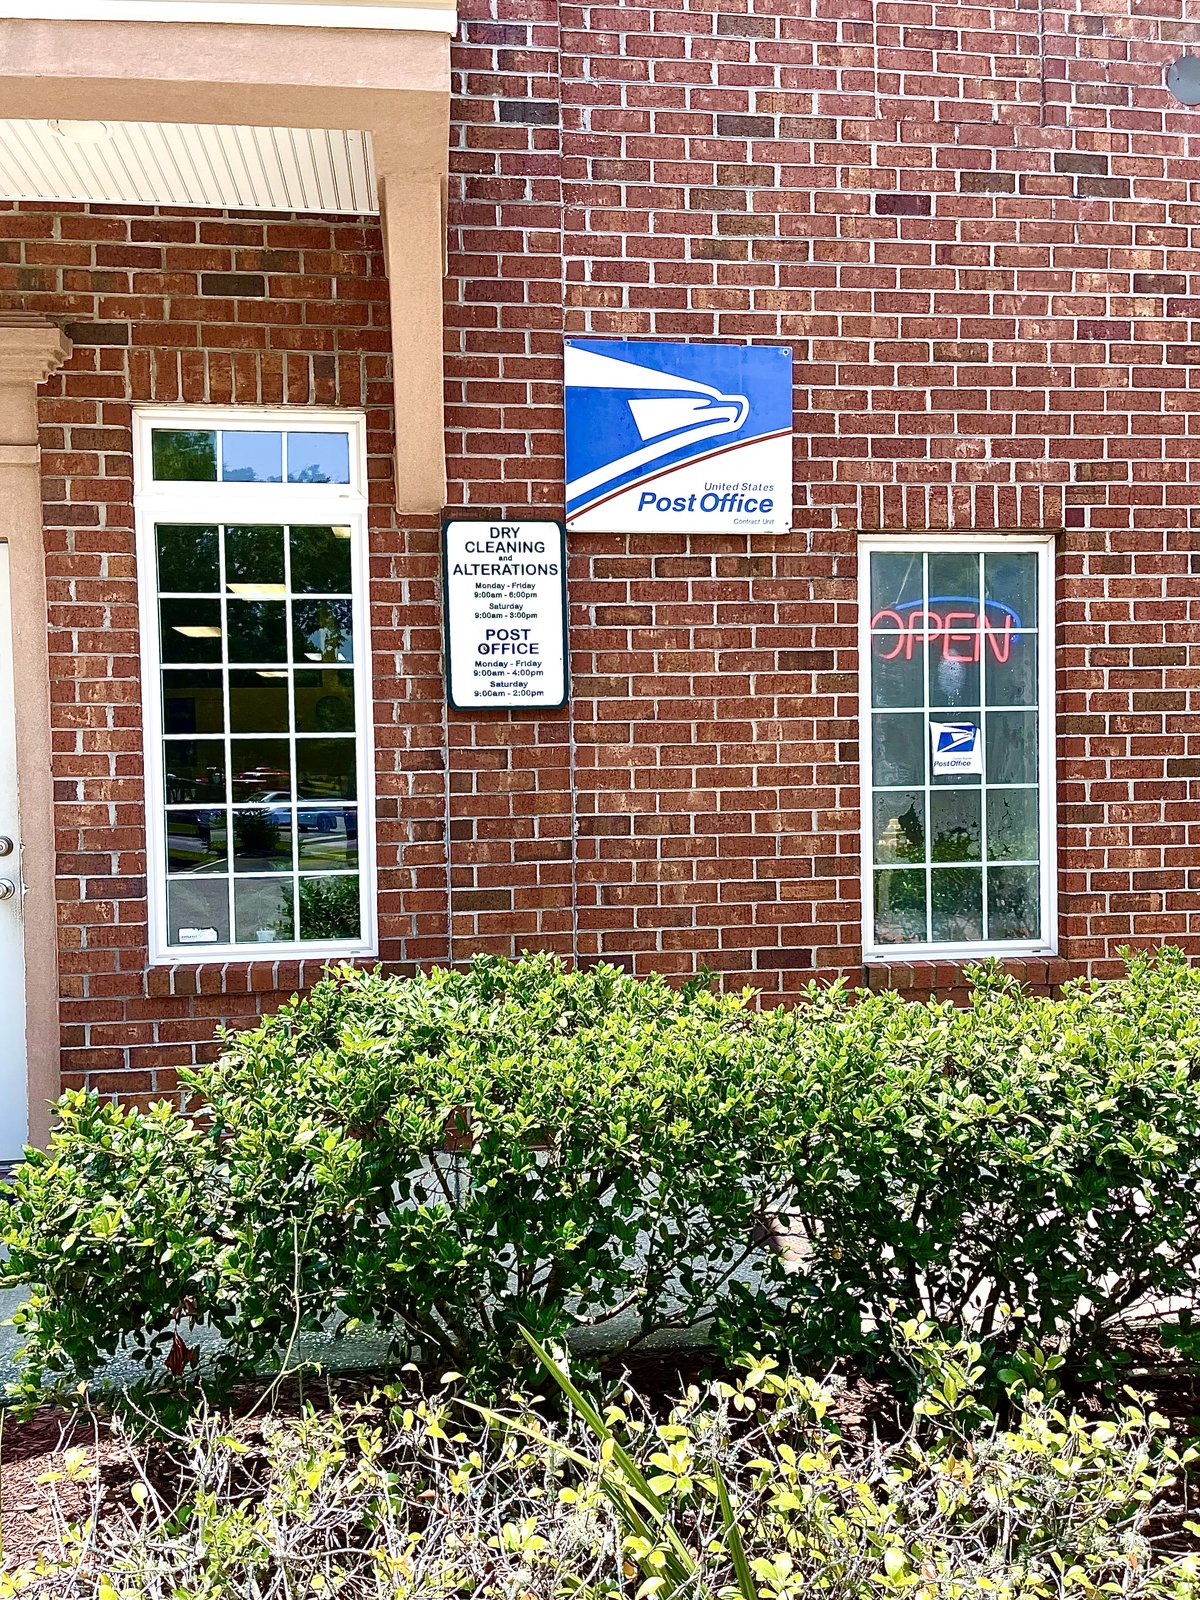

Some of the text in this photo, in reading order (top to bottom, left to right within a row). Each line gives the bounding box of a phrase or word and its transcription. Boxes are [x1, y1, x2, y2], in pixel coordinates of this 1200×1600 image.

[704, 482, 775, 492] United States
[637, 491, 774, 513] Post Office
[489, 526, 520, 538] DRY
[464, 541, 546, 553] CLEANING
[452, 563, 559, 576] ALTERATIONS
[475, 582, 506, 590] Monday
[511, 582, 536, 590] Friday
[509, 591, 538, 599] 6:00pm
[489, 603, 524, 611] Saturday
[509, 612, 538, 620] 3:00pm
[486, 629, 531, 641] POST
[871, 609, 1011, 663] OPEN
[478, 643, 540, 655] OFFICE
[474, 661, 508, 669] Monday
[515, 660, 542, 668] Friday
[512, 669, 544, 677] 4:00pm
[490, 681, 528, 689] Saturday
